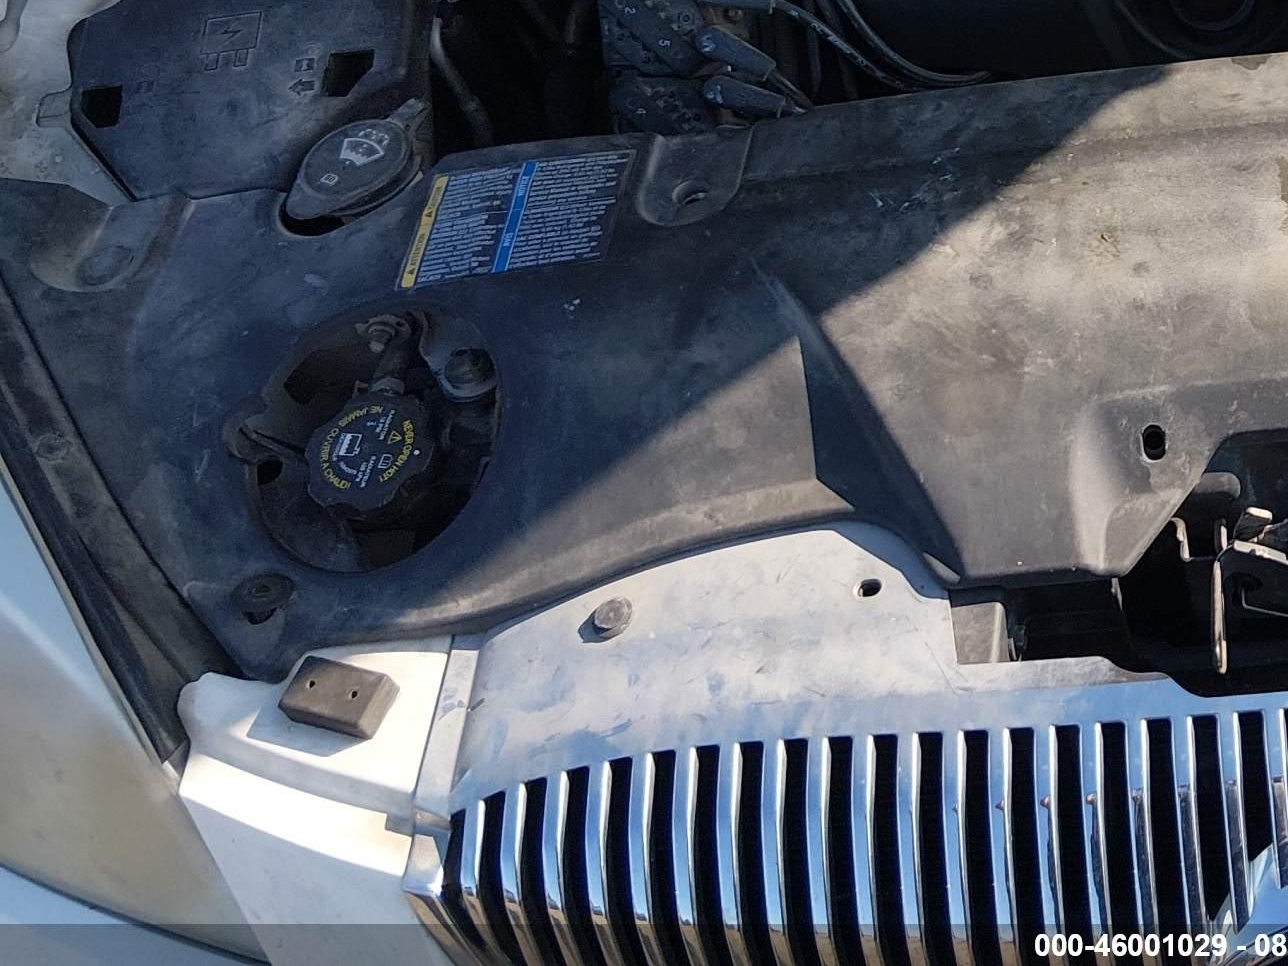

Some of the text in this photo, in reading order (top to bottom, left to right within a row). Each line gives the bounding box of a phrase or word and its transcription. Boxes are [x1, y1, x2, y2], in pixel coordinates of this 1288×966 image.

[658, 39, 671, 47] 5
[338, 407, 369, 428] JAMAIS
[402, 419, 415, 444] NEVER
[396, 445, 412, 466] OPEN
